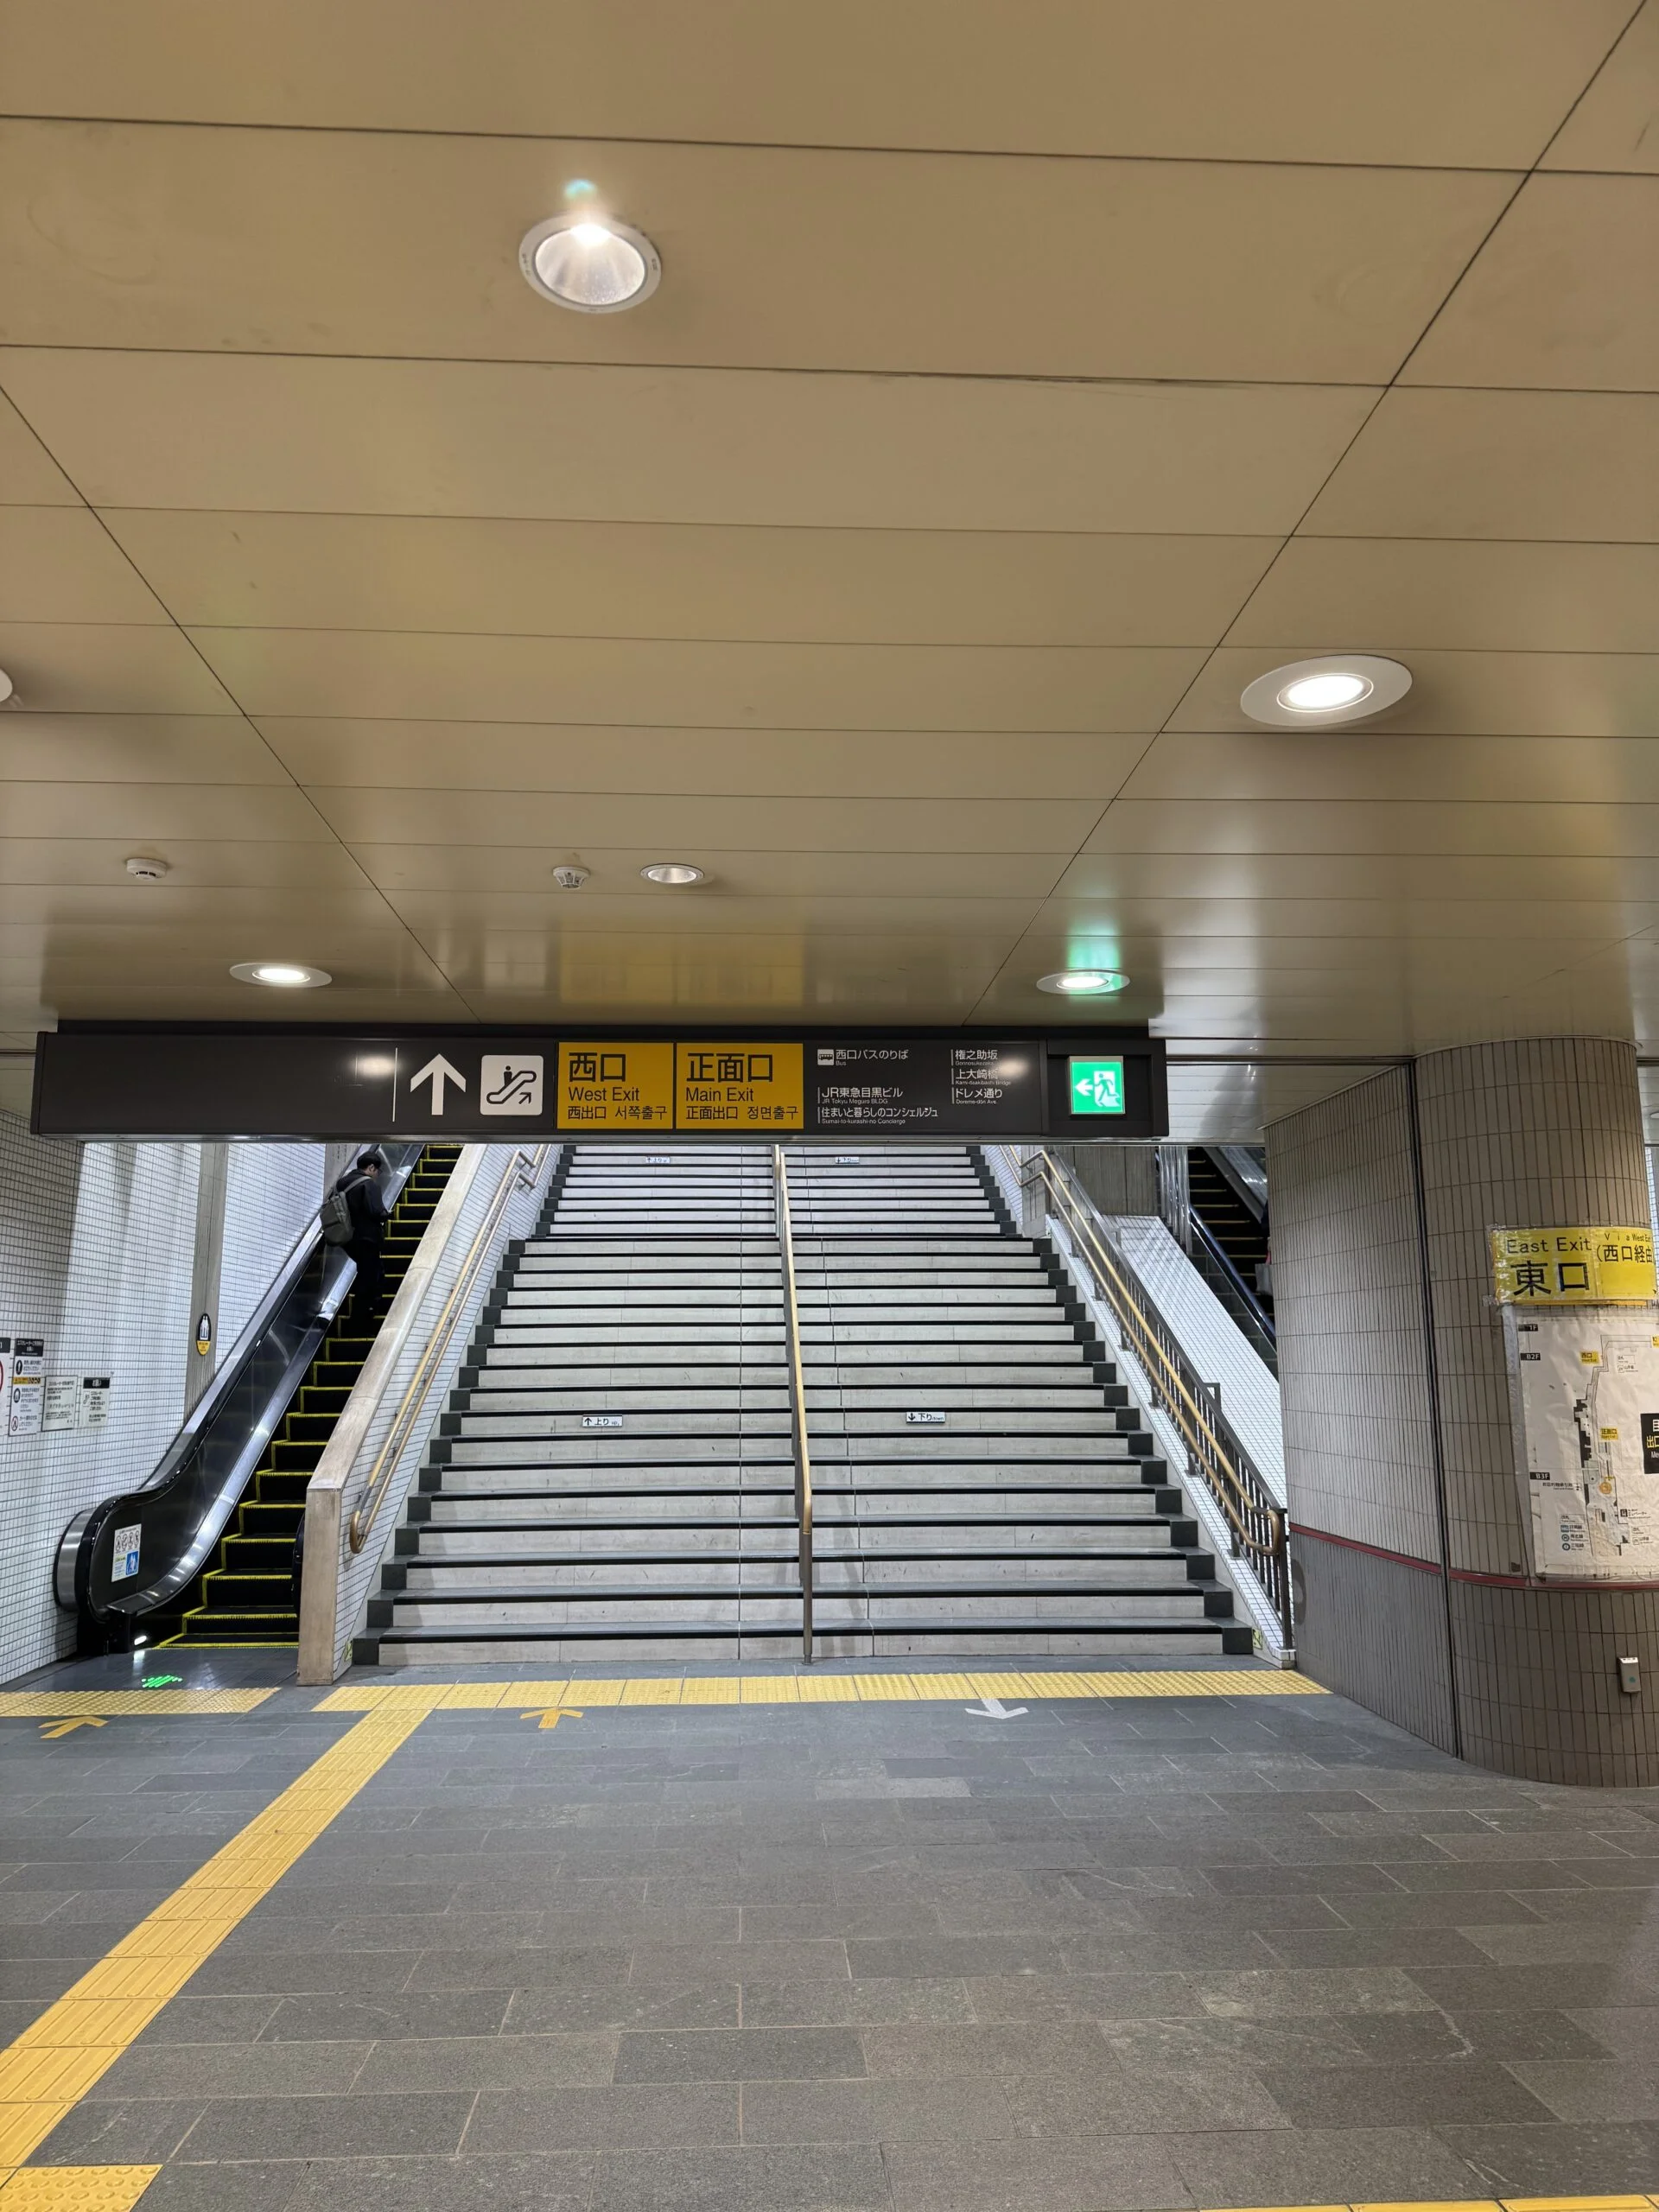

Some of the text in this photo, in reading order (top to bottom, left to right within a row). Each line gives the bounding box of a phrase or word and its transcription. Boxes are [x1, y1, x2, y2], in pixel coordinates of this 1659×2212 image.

[836, 1049, 909, 1060] 西口バスのりば
[955, 1049, 998, 1060] 権之助坂
[569, 1052, 626, 1083] 西口
[686, 1052, 773, 1083] 正面口
[569, 1087, 639, 1102] West Exit
[685, 1087, 754, 1102] Main Exit
[822, 1087, 903, 1098] JR東急目黒ビル
[956, 1088, 1002, 1099] ドレメ通り
[568, 1106, 607, 1120] 西出口
[614, 1106, 668, 1120] 서쪽출구
[686, 1106, 738, 1120] 正面出口
[747, 1106, 799, 1121] 정면출구
[822, 1107, 938, 1117] 住まいと暮らしのコンシェルジュ
[1507, 1236, 1592, 1254] East Exit
[1510, 1260, 1590, 1297] 東口
[594, 1417, 609, 1426] 上り
